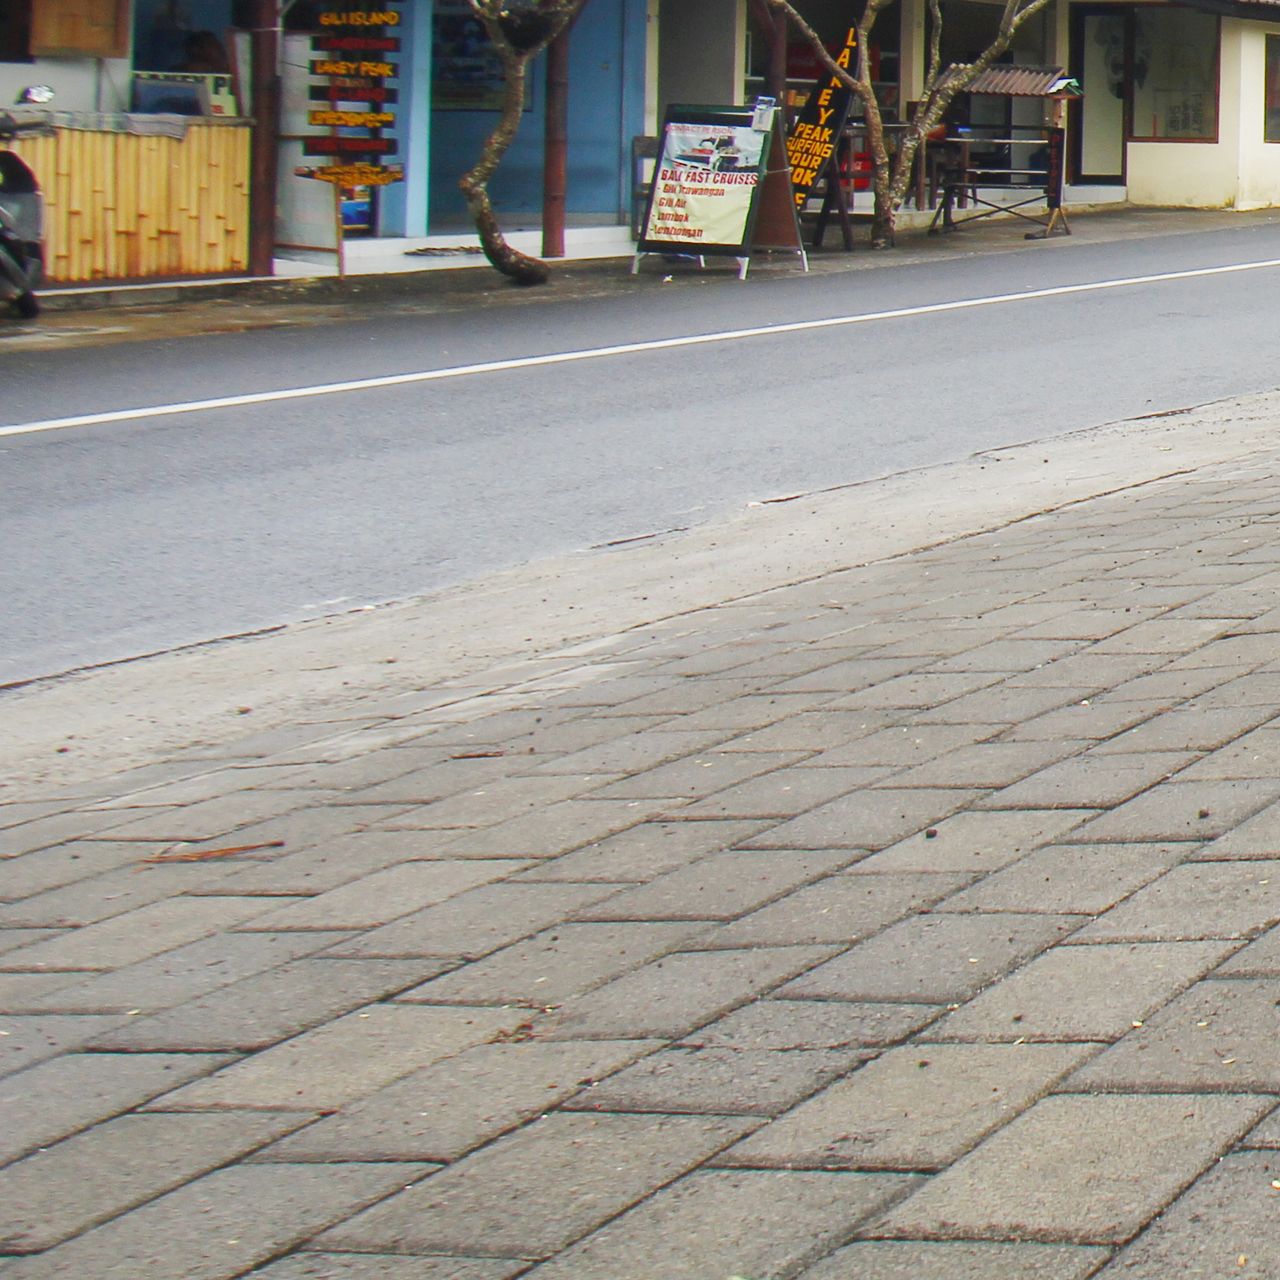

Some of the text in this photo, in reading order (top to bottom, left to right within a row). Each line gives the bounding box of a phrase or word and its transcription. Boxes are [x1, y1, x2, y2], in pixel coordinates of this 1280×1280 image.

[795, 123, 833, 142] PEAK
[661, 169, 759, 186] BALI FAST CRUISES
